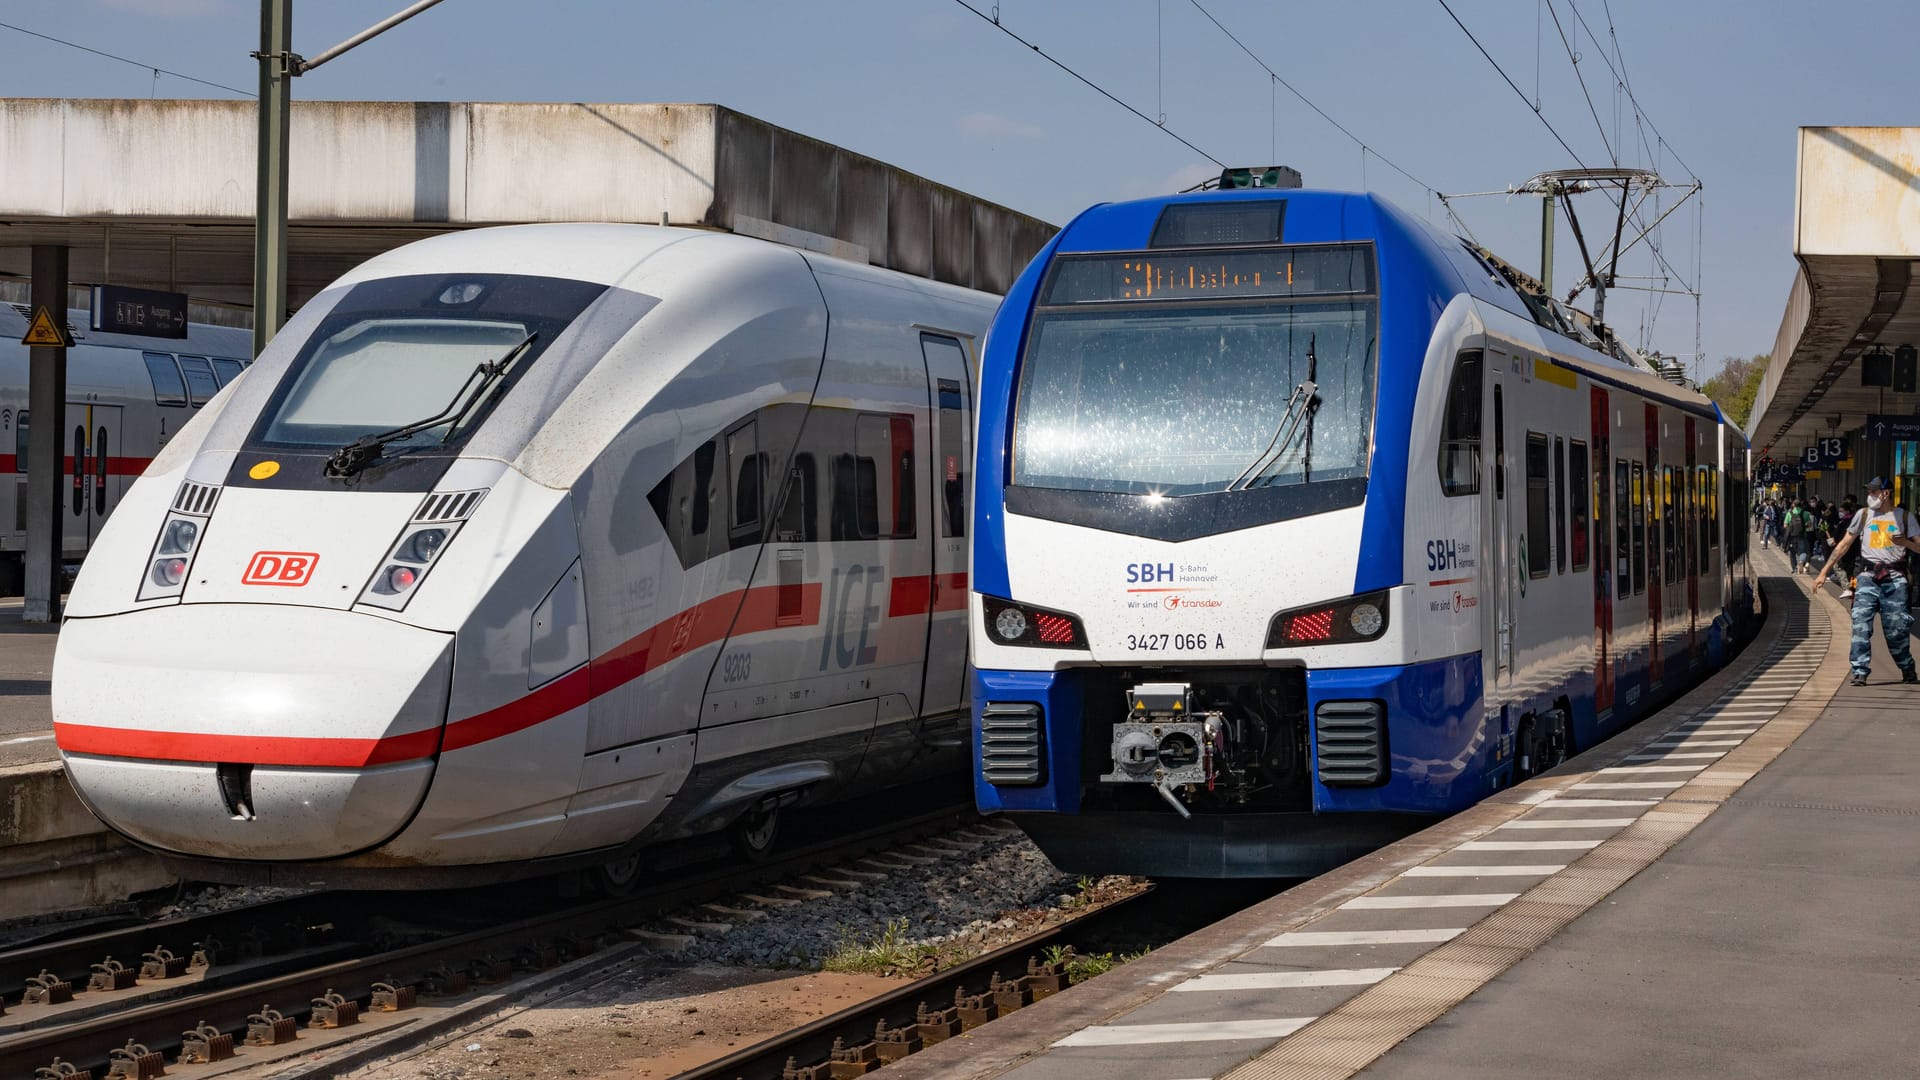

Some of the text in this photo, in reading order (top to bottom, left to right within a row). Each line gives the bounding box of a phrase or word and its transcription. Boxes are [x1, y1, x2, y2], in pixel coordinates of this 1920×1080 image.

[160, 416, 166, 436] 1
[1807, 447, 1819, 463] B
[1820, 438, 1842, 457] 13
[1780, 464, 1789, 476] C
[1426, 538, 1457, 572] SBH
[250, 556, 309, 581] DB
[1126, 562, 1175, 583] SBH
[1179, 565, 1208, 573] S-Bahn
[1179, 575, 1218, 583] Hannover
[1127, 600, 1158, 609] Wir sind
[1181, 599, 1223, 608] transdev
[819, 564, 885, 672] ICE
[1127, 632, 1225, 651] 3427 066 A
[723, 652, 751, 684] 9203
